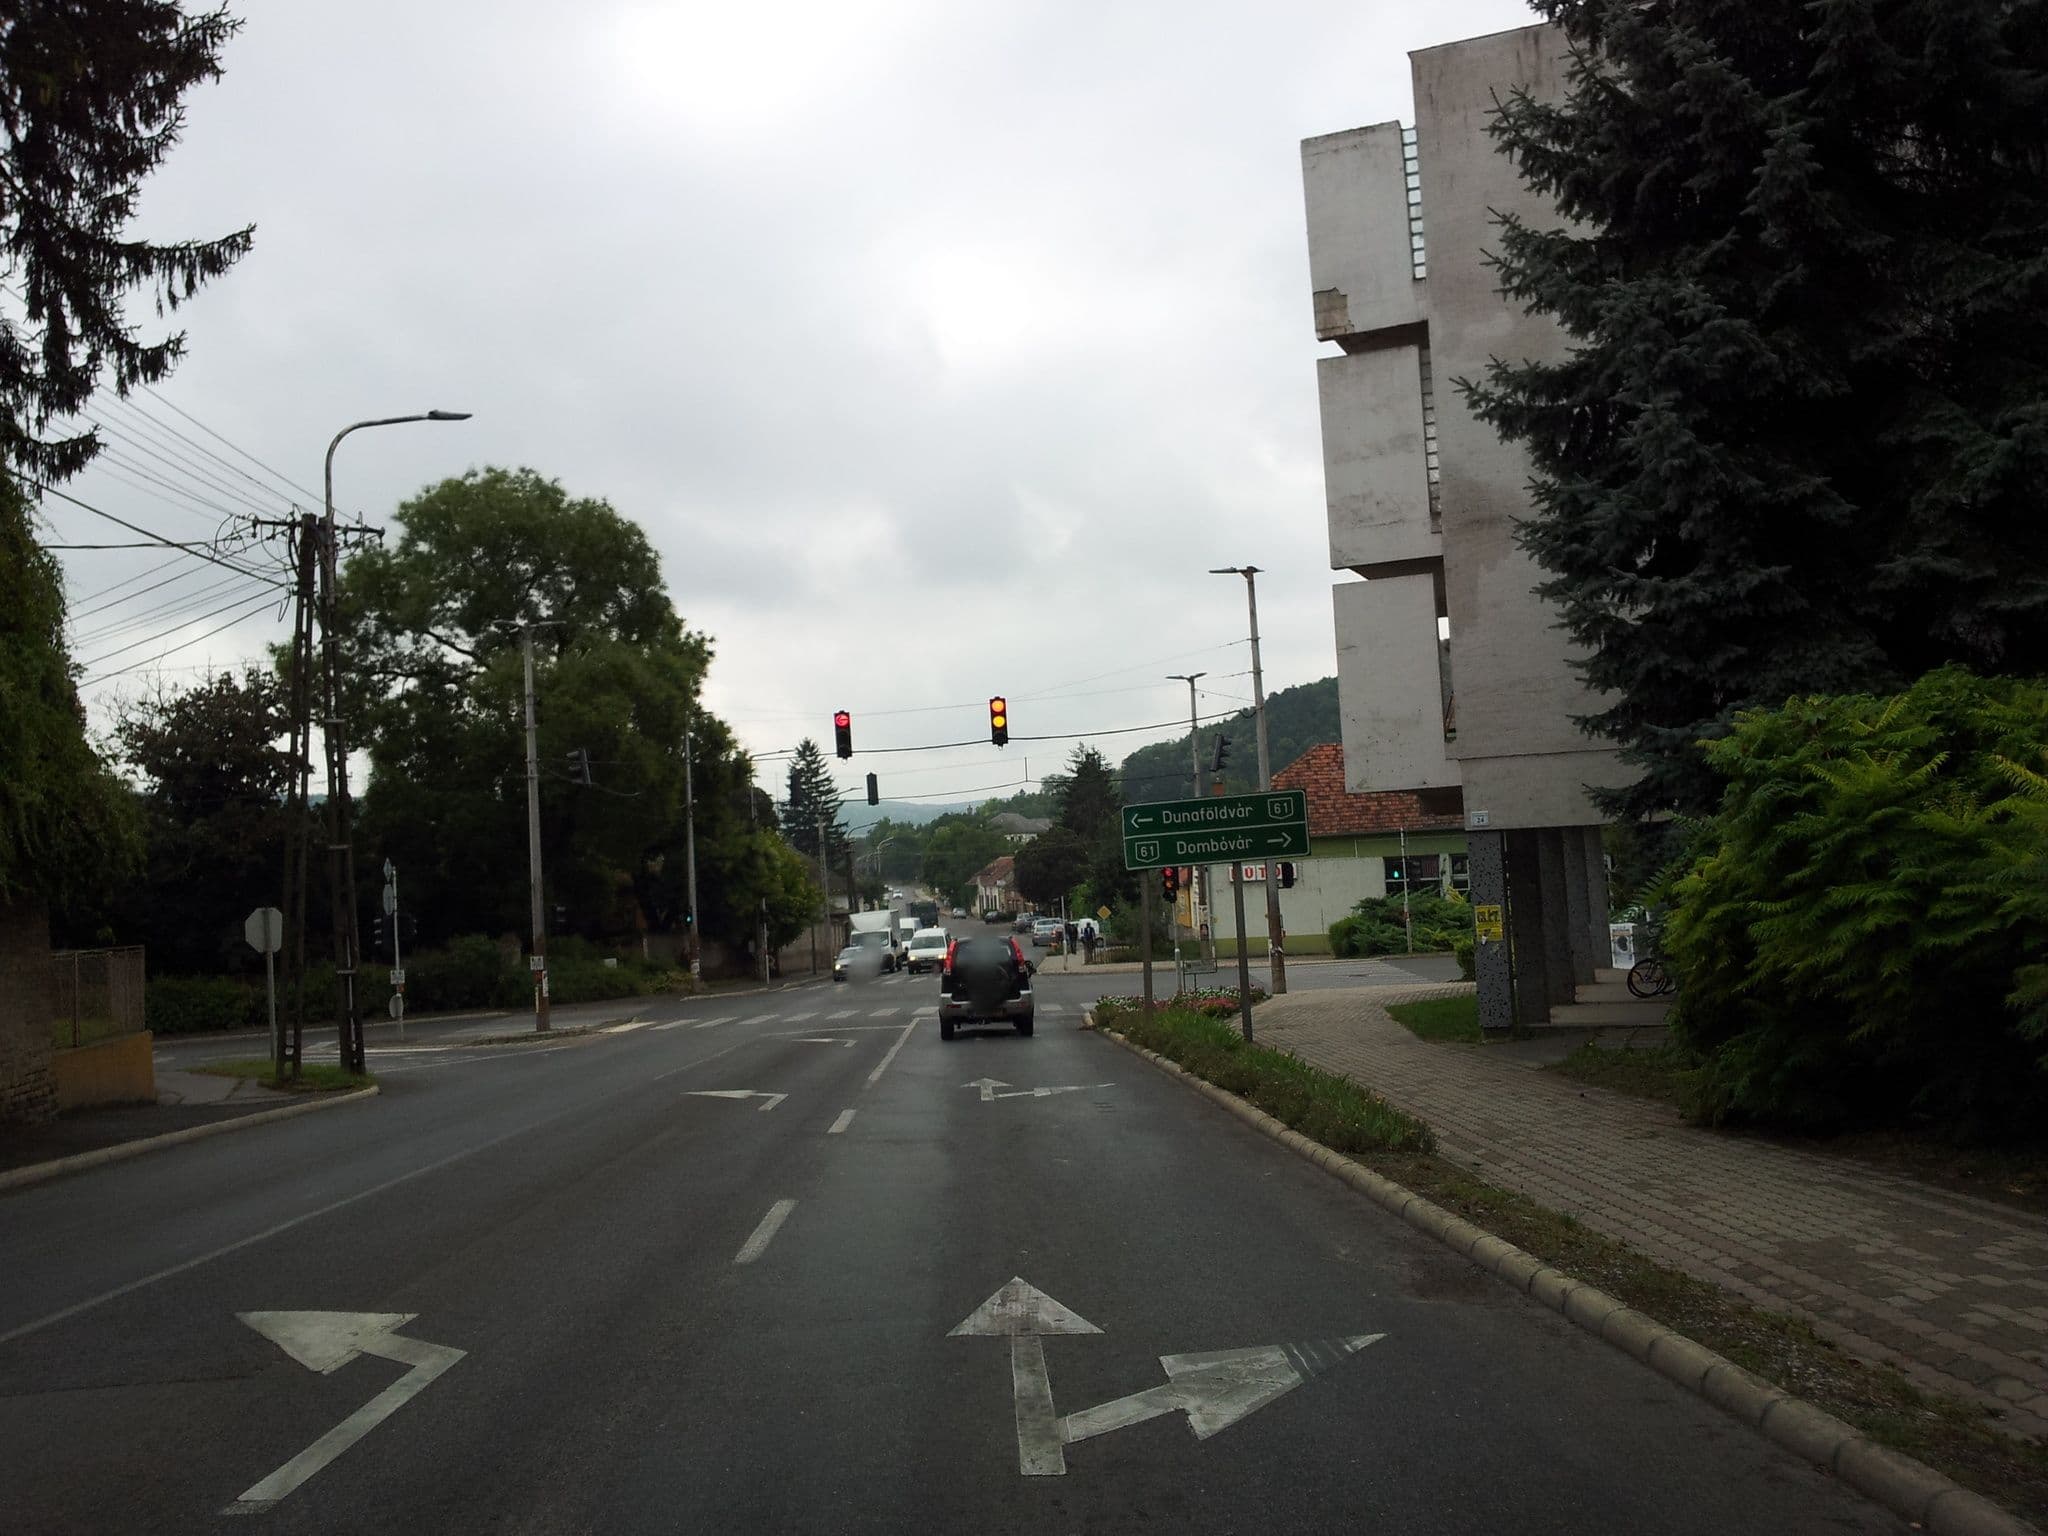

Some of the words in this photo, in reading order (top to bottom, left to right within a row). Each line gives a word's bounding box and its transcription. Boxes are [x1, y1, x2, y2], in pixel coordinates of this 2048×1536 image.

[1162, 803, 1254, 824] Dunaföldvár
[1273, 802, 1288, 815] 61
[1140, 846, 1154, 858] 61
[1176, 835, 1254, 855] Dombóvár
